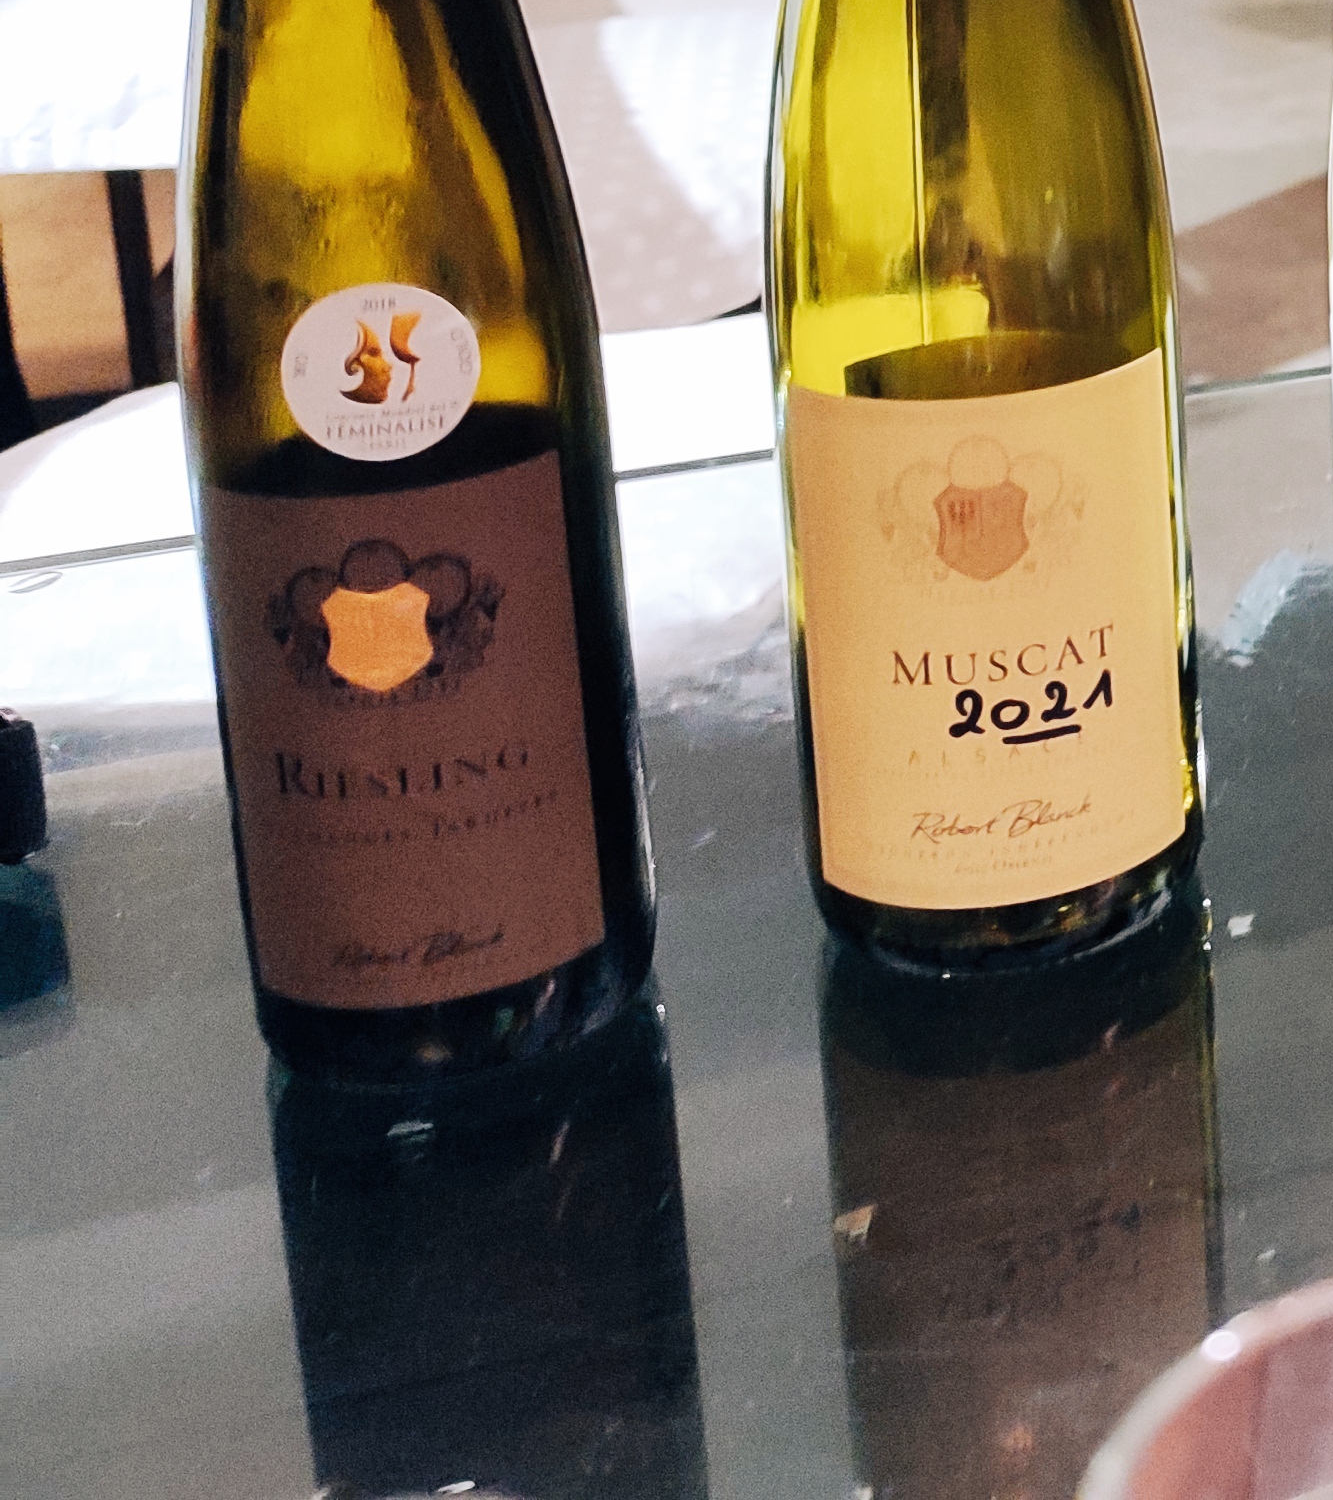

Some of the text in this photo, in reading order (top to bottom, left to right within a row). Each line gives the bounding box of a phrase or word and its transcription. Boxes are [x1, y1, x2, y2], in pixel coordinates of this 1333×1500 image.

[362, 297, 397, 312] 2018
[892, 623, 1114, 687] MUSCAT
[949, 668, 1113, 739] 2021
[911, 792, 1092, 845] Robert Blanck
